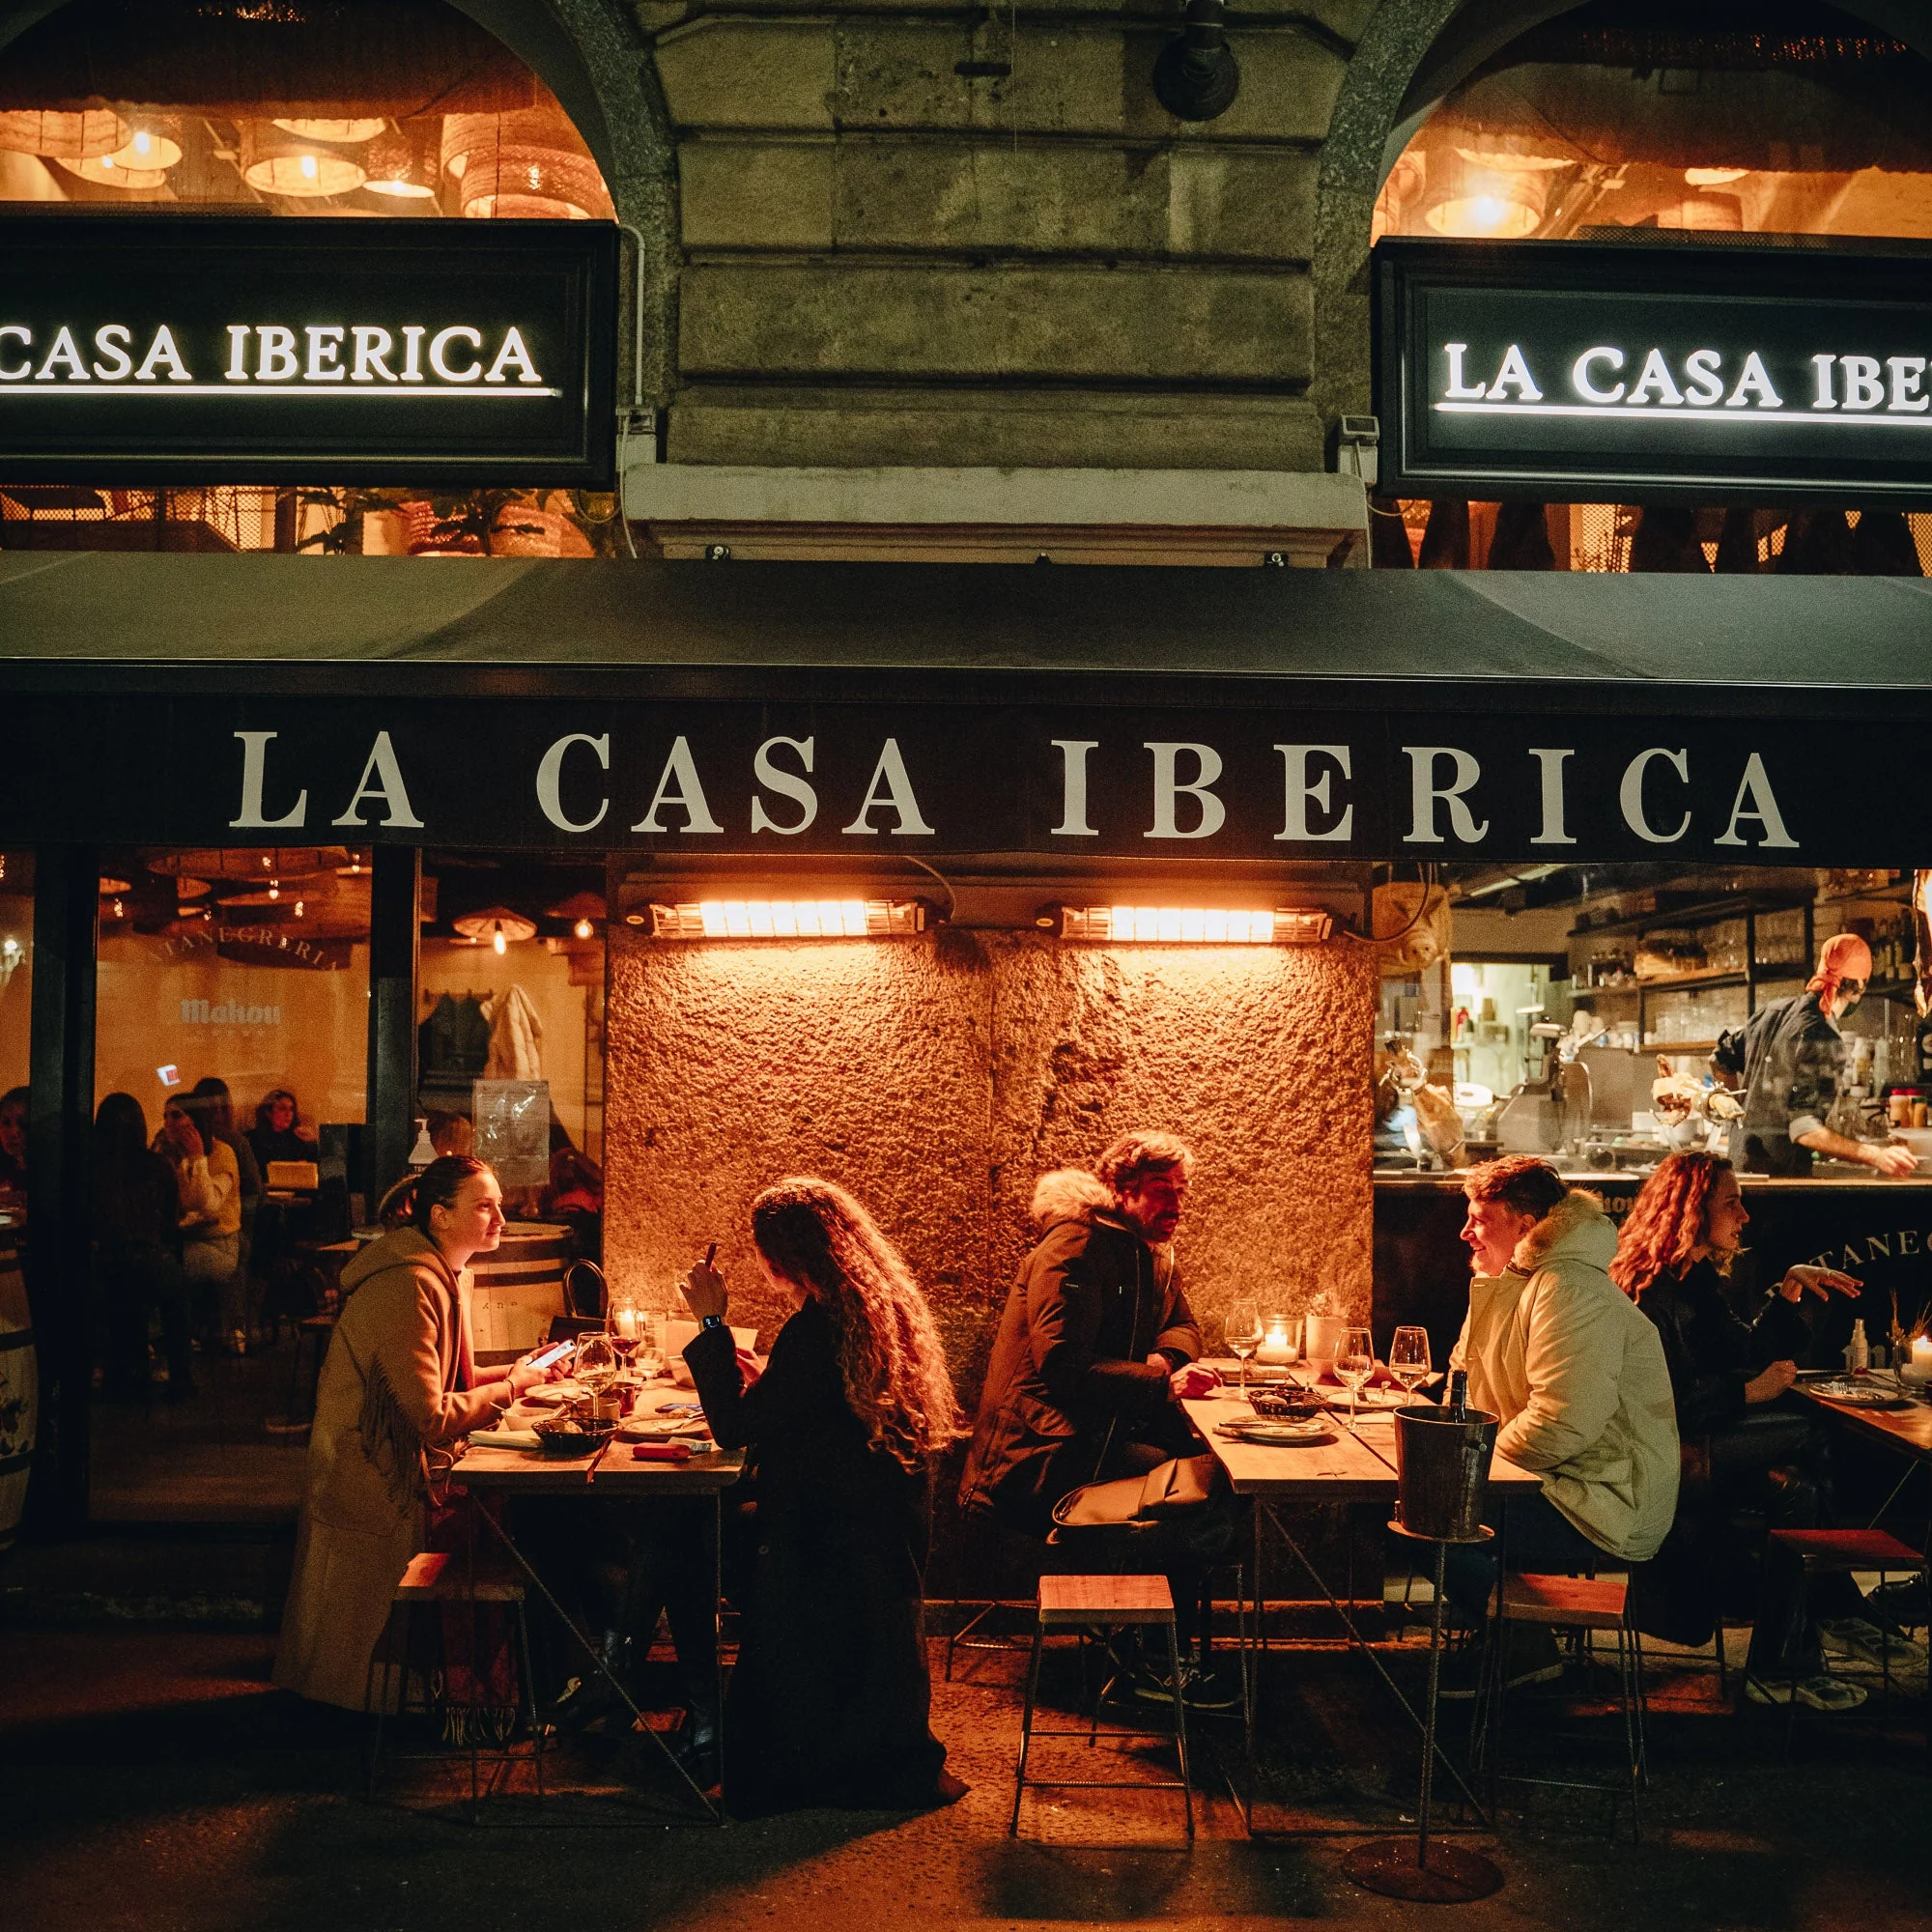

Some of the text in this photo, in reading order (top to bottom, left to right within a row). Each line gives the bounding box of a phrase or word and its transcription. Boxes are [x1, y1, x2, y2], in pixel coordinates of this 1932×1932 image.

[0, 324, 543, 383] CASA IBERICA
[1444, 343, 1932, 412] LA CASA IBE
[228, 729, 1801, 849] LA CASA IBERICA
[180, 998, 282, 1026] Mahou
